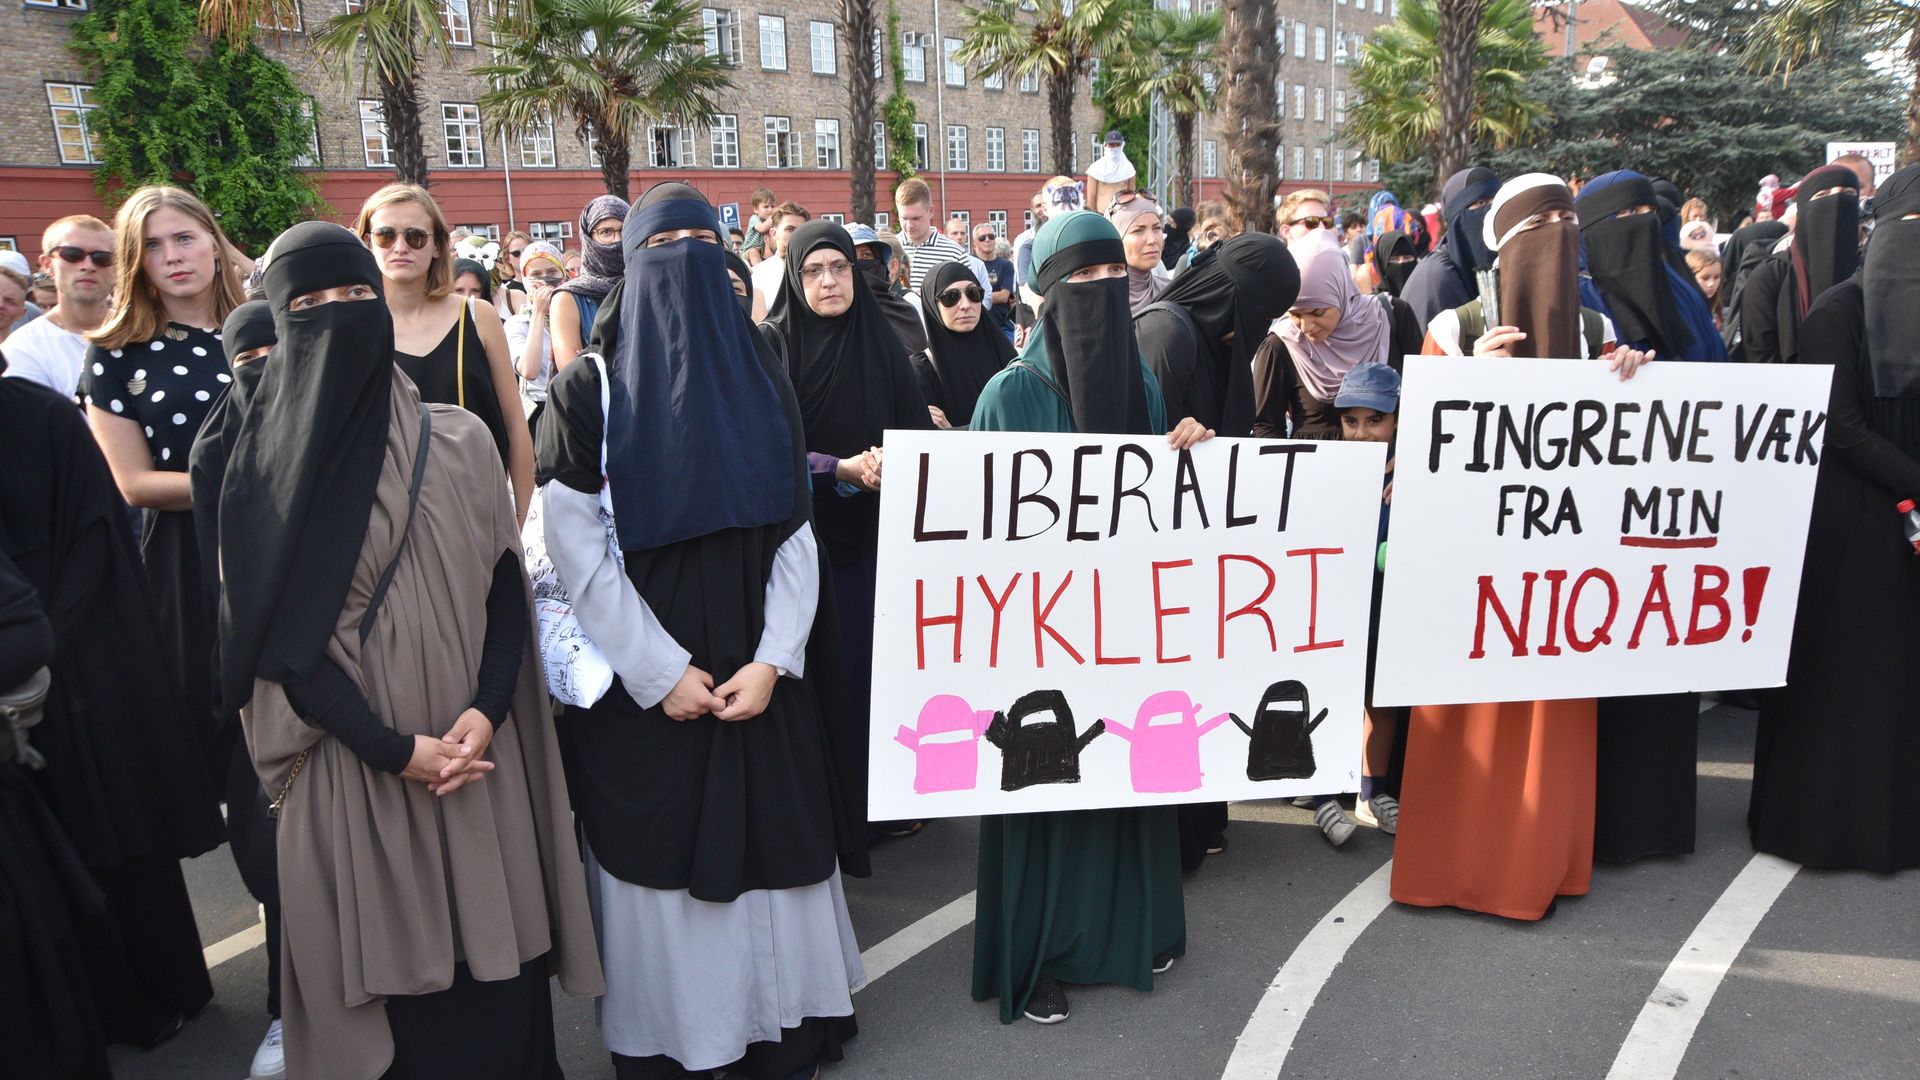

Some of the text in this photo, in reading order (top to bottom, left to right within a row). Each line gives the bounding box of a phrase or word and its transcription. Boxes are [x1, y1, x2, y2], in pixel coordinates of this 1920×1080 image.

[722, 206, 733, 223] P
[1429, 400, 1827, 473] FINGRENE VÆK
[914, 444, 1317, 543] LIBERALT
[1497, 485, 1722, 539] FRA MIN
[916, 548, 1344, 669] HYKLERI
[1469, 564, 1770, 659] NIQAB!
